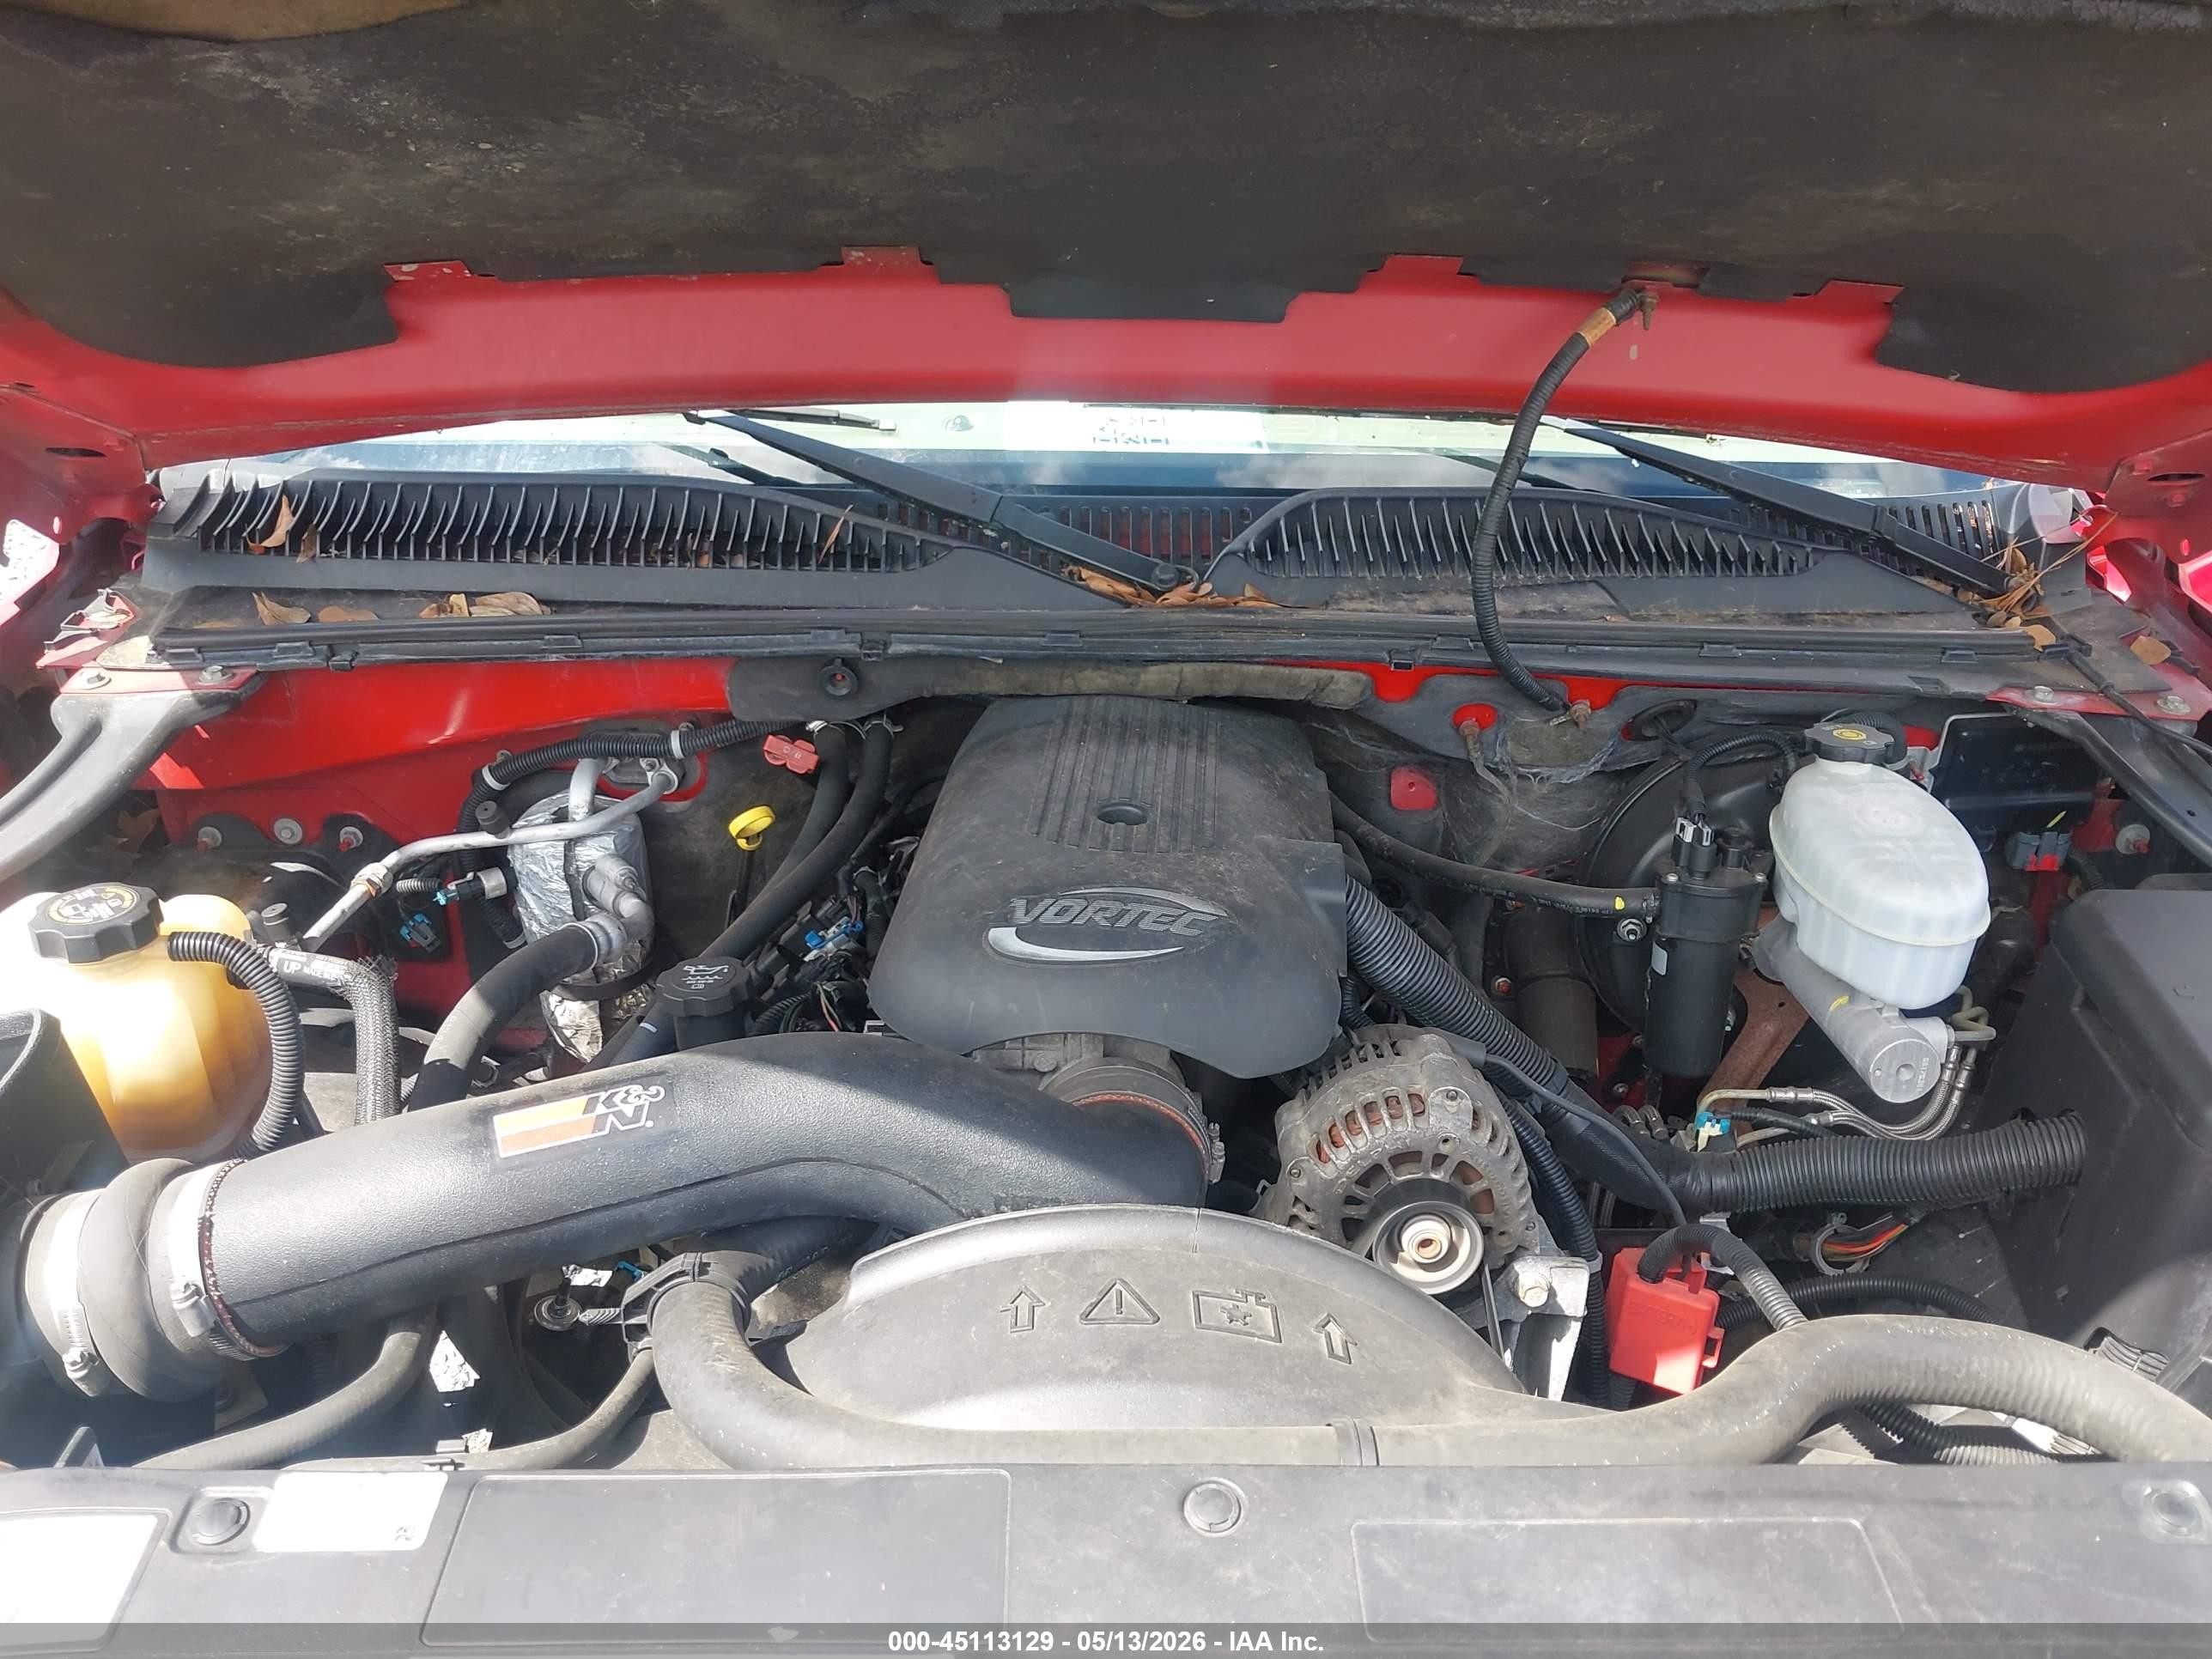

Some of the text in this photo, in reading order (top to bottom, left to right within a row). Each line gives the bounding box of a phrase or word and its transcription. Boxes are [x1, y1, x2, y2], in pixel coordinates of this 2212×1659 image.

[1009, 897, 1220, 937] VORTEC
[283, 960, 302, 975] UP
[581, 1084, 666, 1135] K&N
